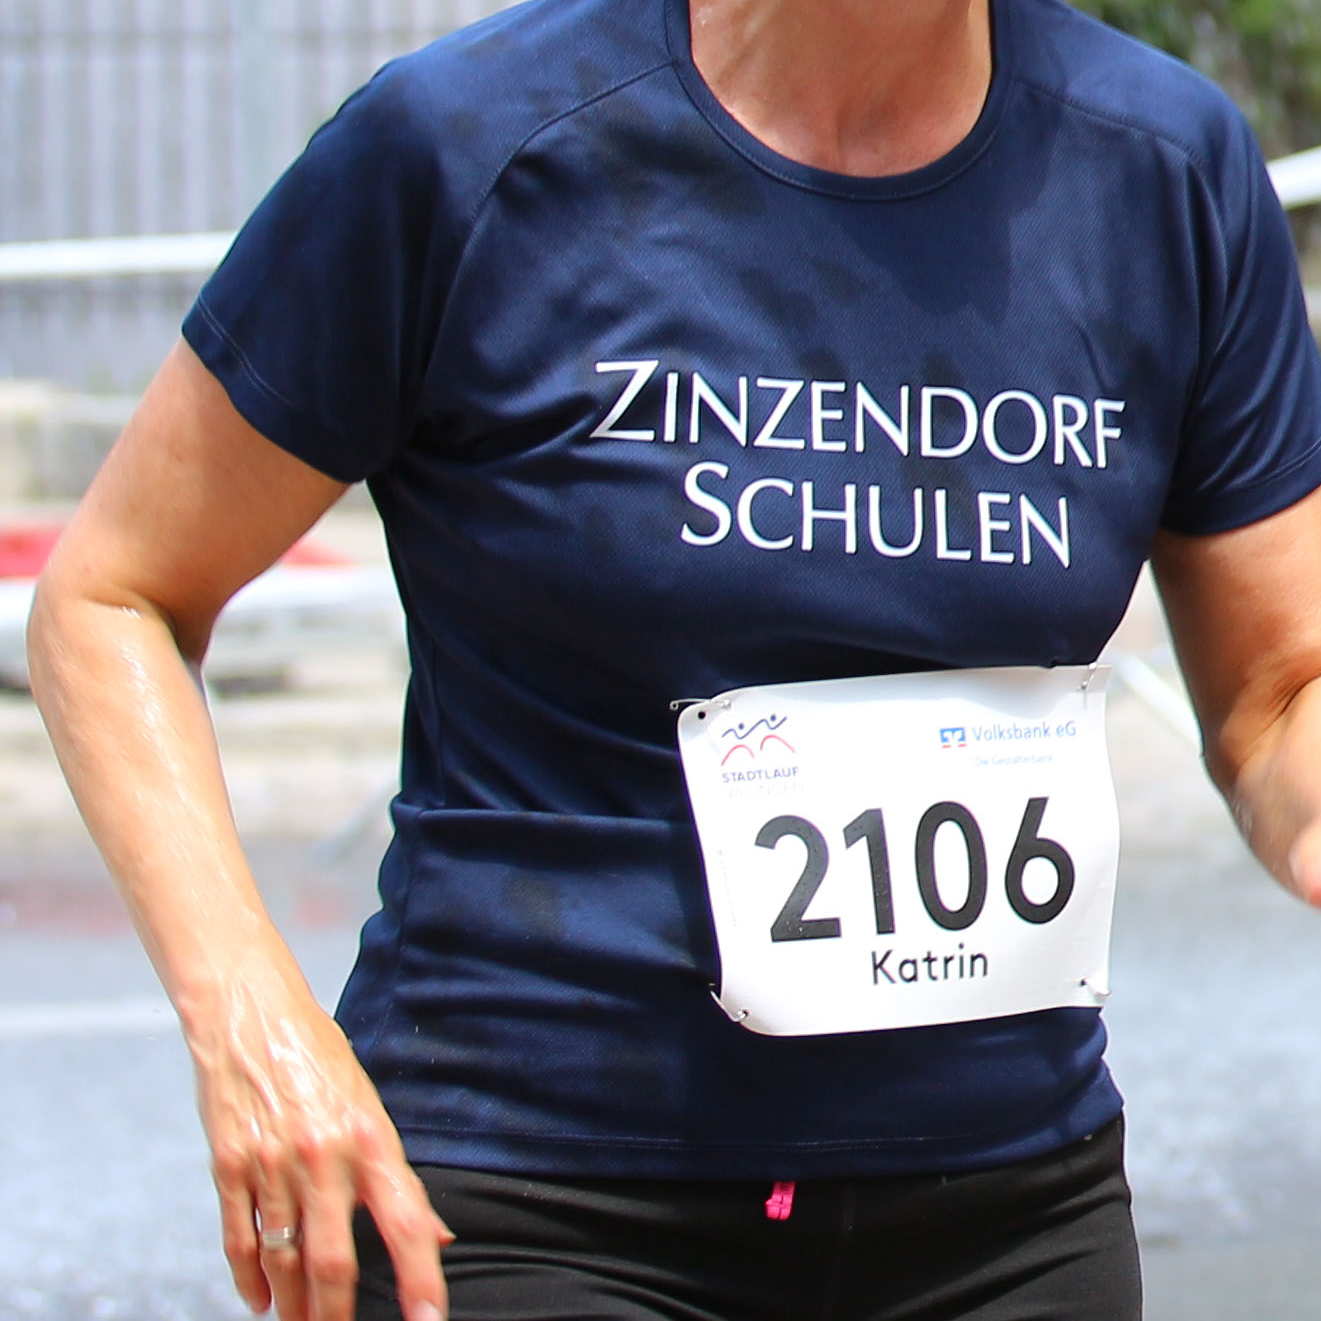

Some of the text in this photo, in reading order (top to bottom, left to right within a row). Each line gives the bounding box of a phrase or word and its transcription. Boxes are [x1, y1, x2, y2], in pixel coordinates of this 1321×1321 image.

[590, 359, 1126, 469] ZINZENDORF
[680, 461, 1071, 569] SCHULEN
[971, 720, 1077, 742] Volksbank eG
[722, 765, 799, 783] STADTLAUF
[754, 796, 1076, 943] 2106
[871, 942, 988, 985] Katrin
